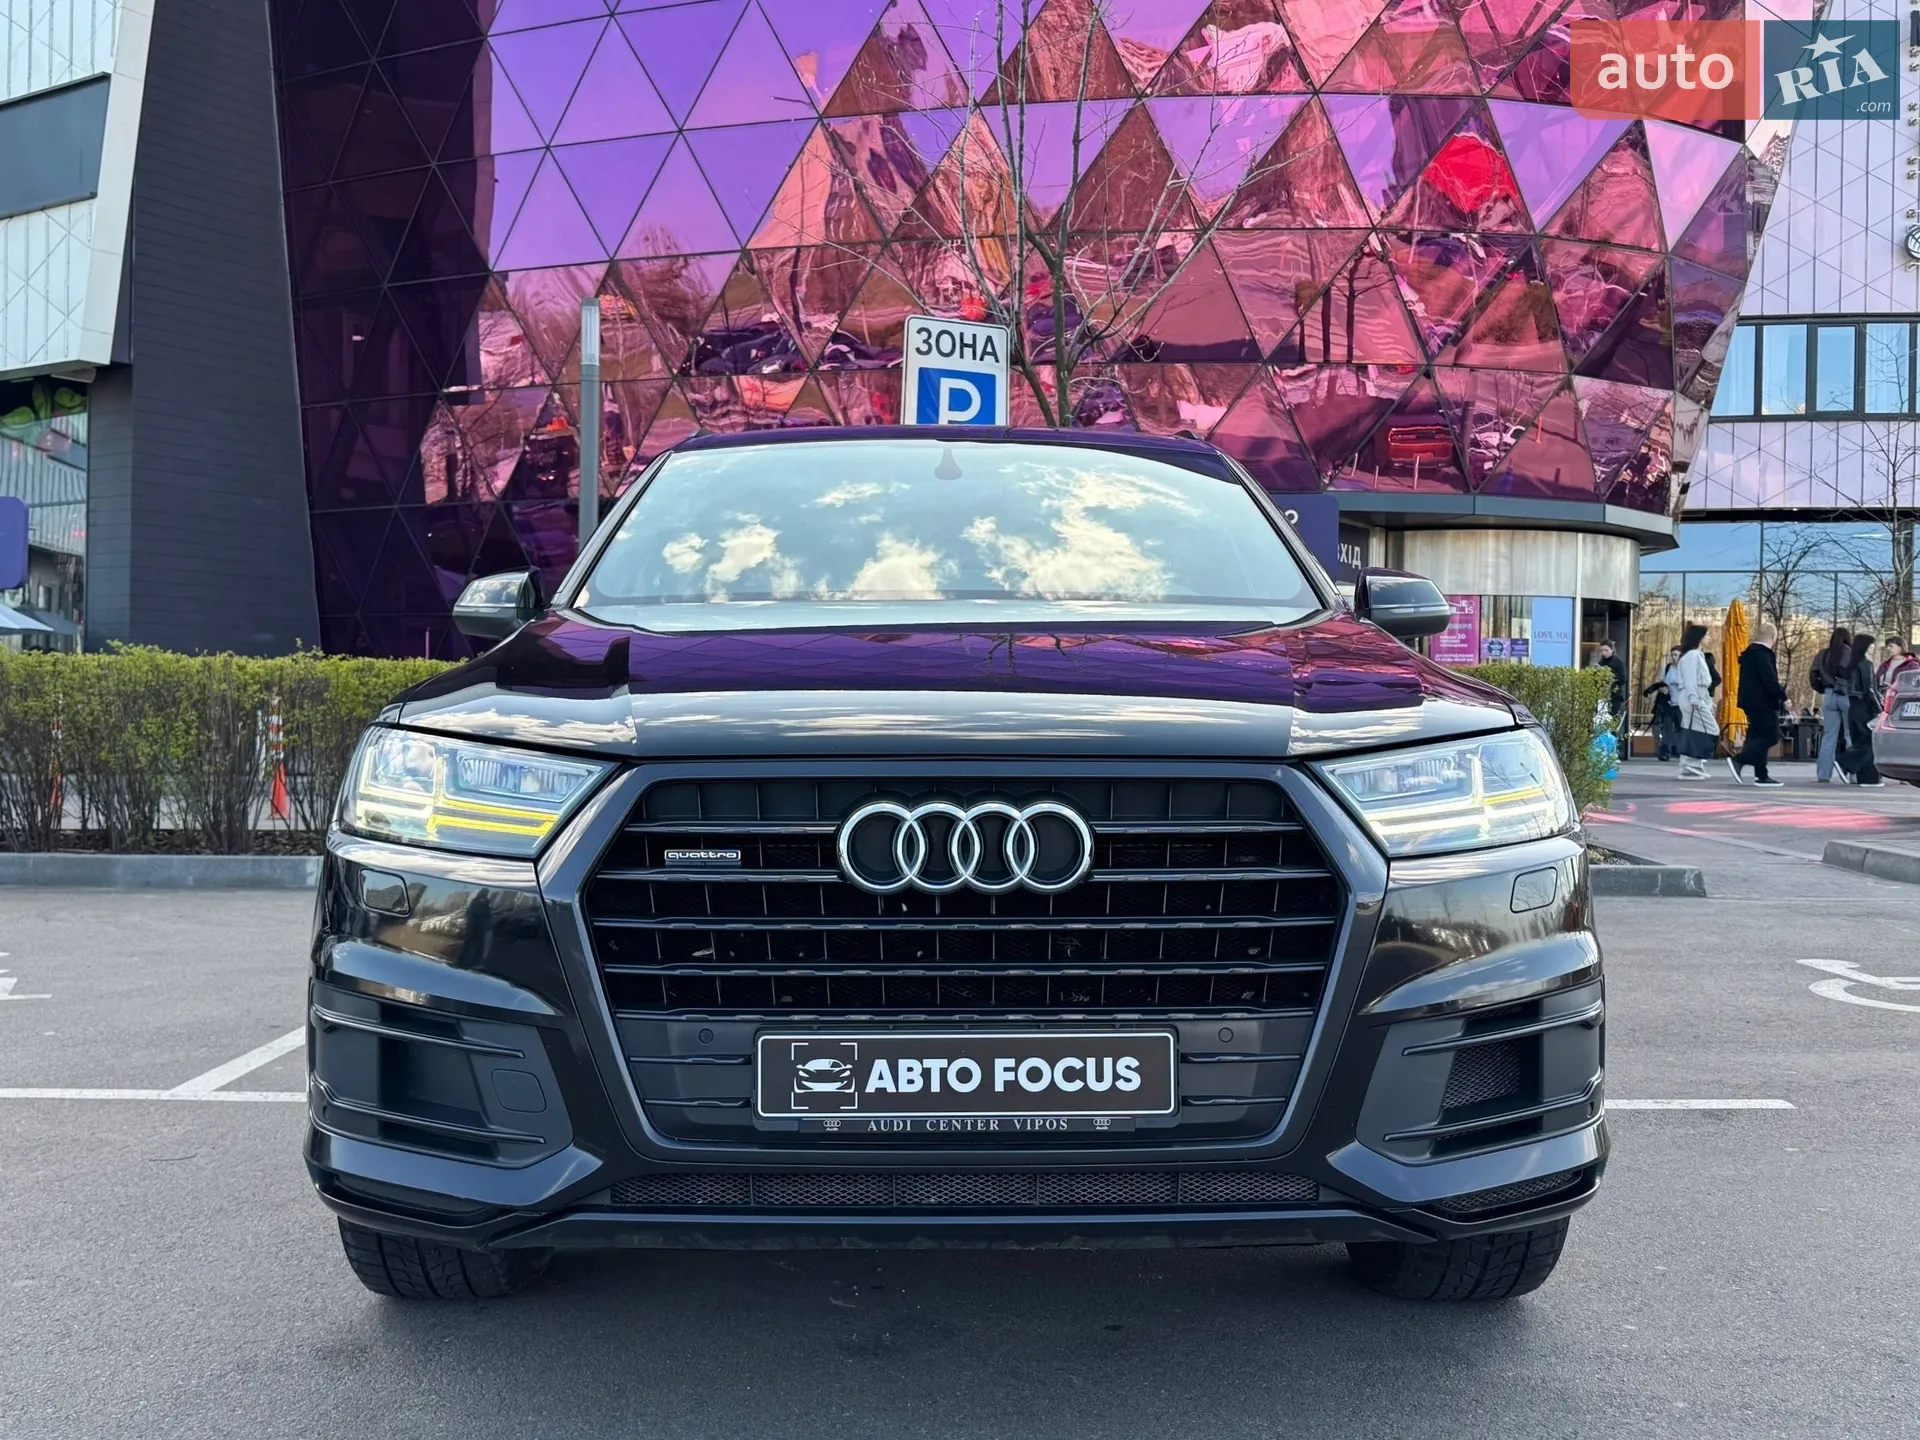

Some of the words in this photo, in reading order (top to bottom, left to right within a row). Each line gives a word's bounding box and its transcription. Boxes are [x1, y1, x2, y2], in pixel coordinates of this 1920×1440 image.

[915, 327, 1000, 363] ЗОНА
[938, 377, 982, 425] P
[1337, 542, 1362, 570] ХІД
[1533, 630, 1553, 640] LOVE
[668, 851, 737, 860] quattro
[994, 1056, 1142, 1092] FOCUS
[867, 1119, 912, 1132] AUDI
[926, 1119, 1000, 1131] CENTER
[1013, 1118, 1068, 1130] VIPOS
